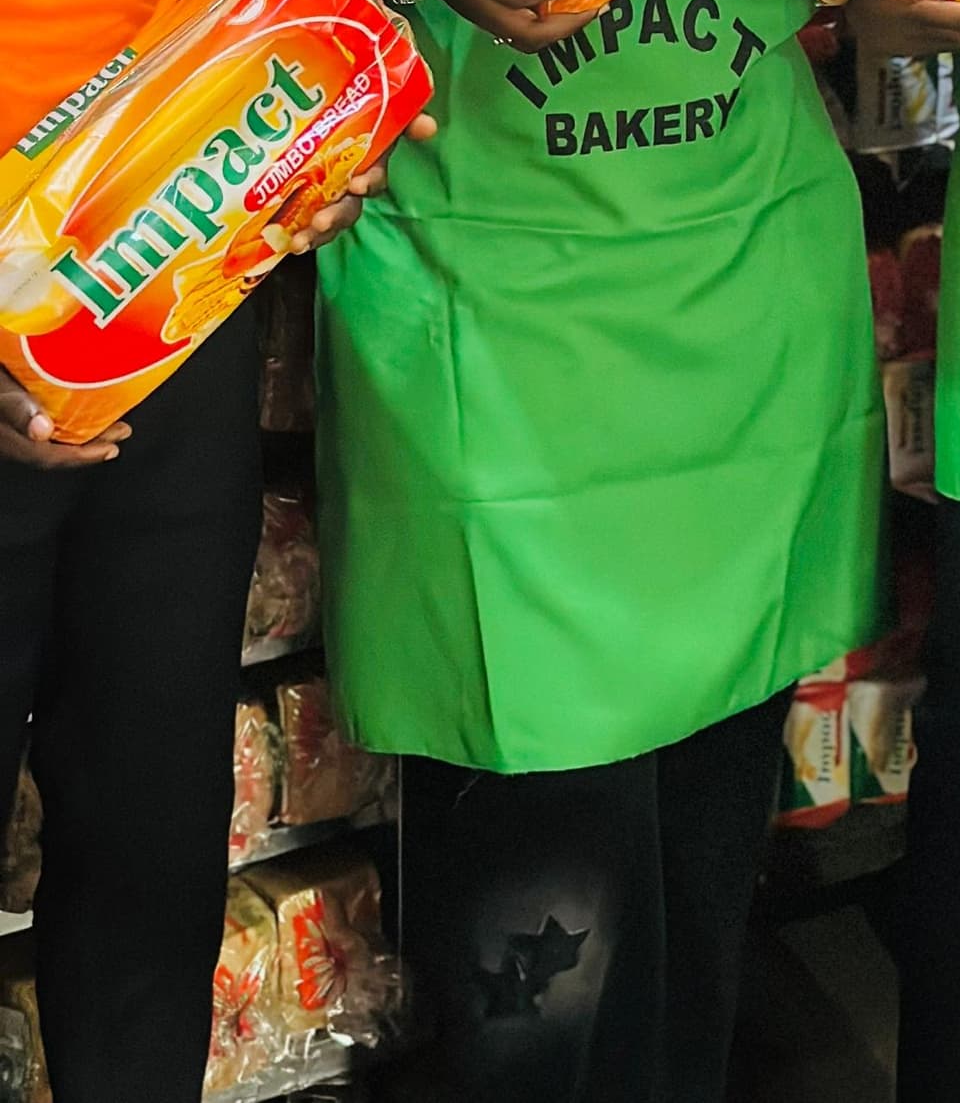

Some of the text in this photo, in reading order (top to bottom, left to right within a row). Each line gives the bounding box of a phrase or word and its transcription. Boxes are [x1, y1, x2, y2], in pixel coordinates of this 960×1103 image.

[545, 87, 741, 156] BAKERY
[50, 54, 324, 328] Impact
[253, 131, 316, 205] JUMBO
